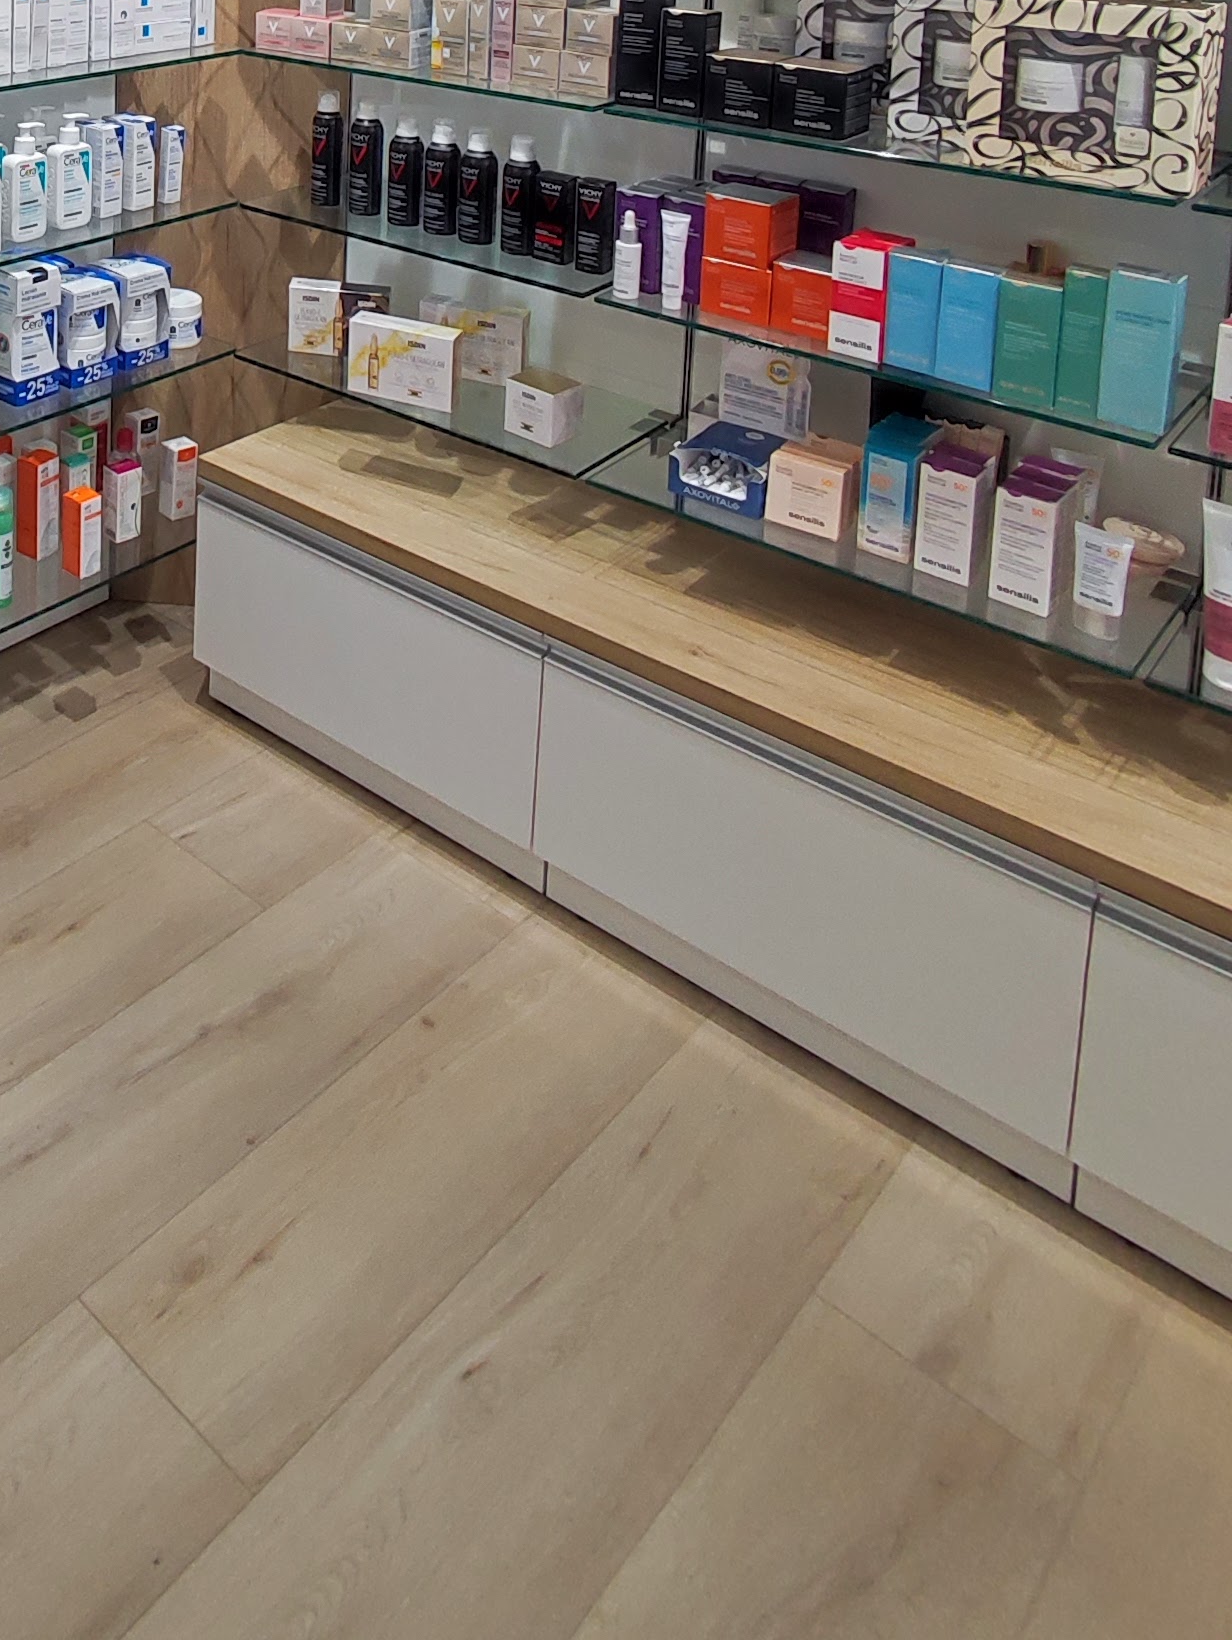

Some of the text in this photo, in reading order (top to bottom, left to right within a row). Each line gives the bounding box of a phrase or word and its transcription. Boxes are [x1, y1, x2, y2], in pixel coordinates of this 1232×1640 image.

[834, 336, 872, 352] sensilis
[683, 487, 734, 509] AXOVITAL
[789, 511, 825, 527] sensilis
[921, 557, 961, 575] sensilis
[996, 584, 1039, 604] sensilis
[1079, 591, 1113, 607] sensilis
